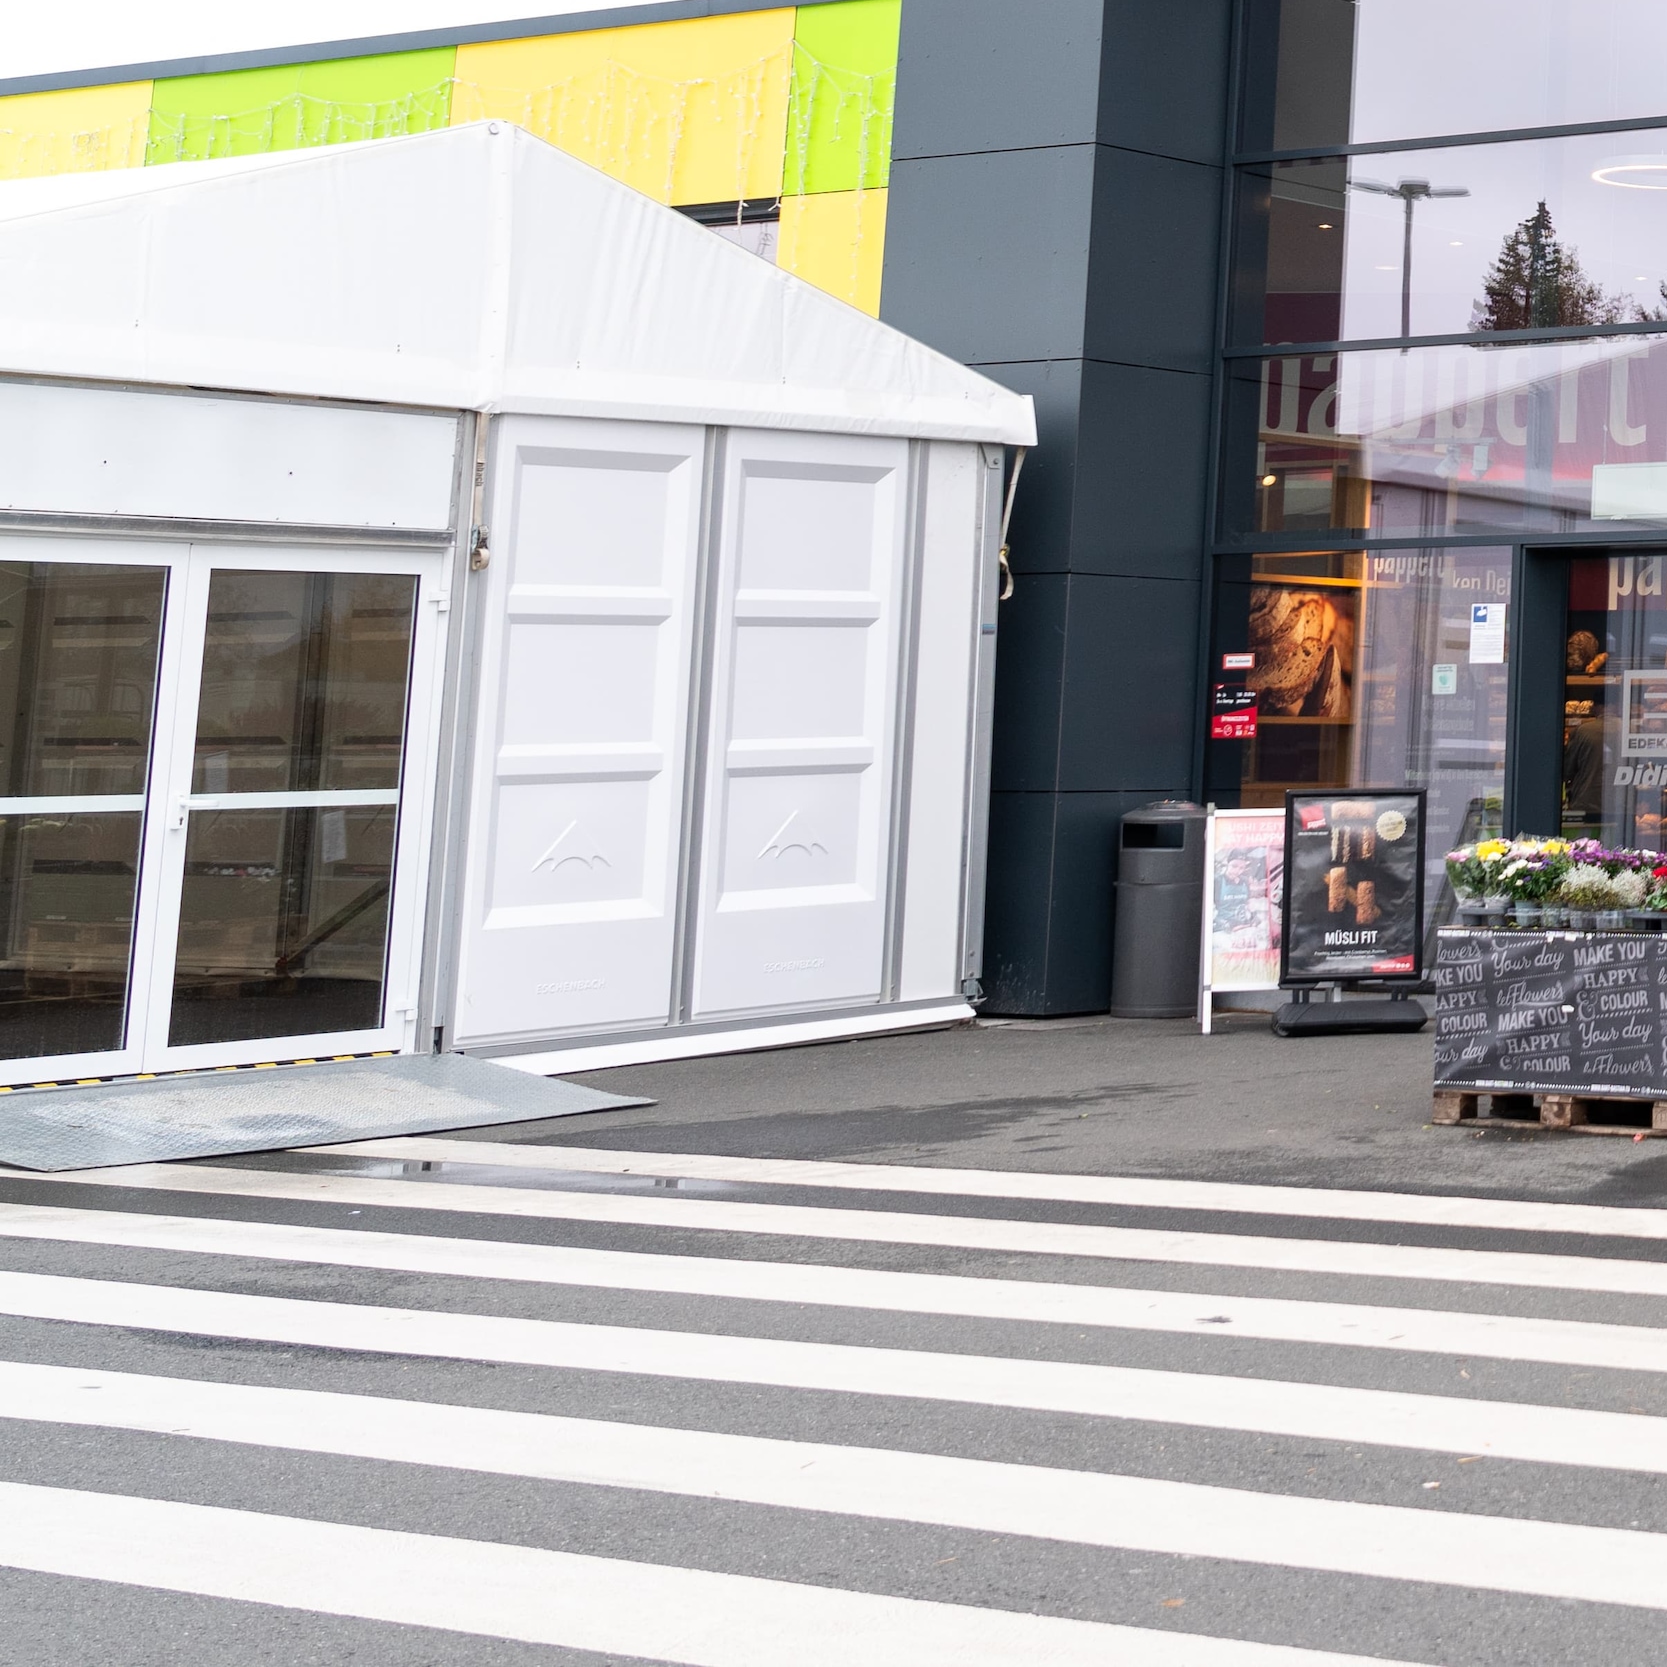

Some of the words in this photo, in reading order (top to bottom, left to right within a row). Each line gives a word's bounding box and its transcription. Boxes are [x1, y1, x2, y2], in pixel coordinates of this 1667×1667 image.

[1325, 930, 1359, 945] MÜSLI
[1361, 930, 1378, 944] FIT
[1491, 952, 1532, 978] Your
[1534, 944, 1565, 971] day
[1573, 943, 1615, 967] MAKE
[1617, 940, 1647, 960] YOU
[763, 957, 825, 974] ESCHENBACH
[1456, 963, 1484, 983] YOU
[536, 978, 606, 995] ESCHENBACH
[1584, 967, 1639, 989] HAPPY
[1600, 990, 1649, 1011] COLOUR
[1441, 1012, 1489, 1034] COLOUR
[1498, 1011, 1535, 1032] MAKE
[1537, 1006, 1568, 1028] YOU
[1579, 1022, 1620, 1048] Your
[1622, 1015, 1654, 1044] day
[1462, 1038, 1489, 1064] day
[1506, 1032, 1562, 1054] HAPPY
